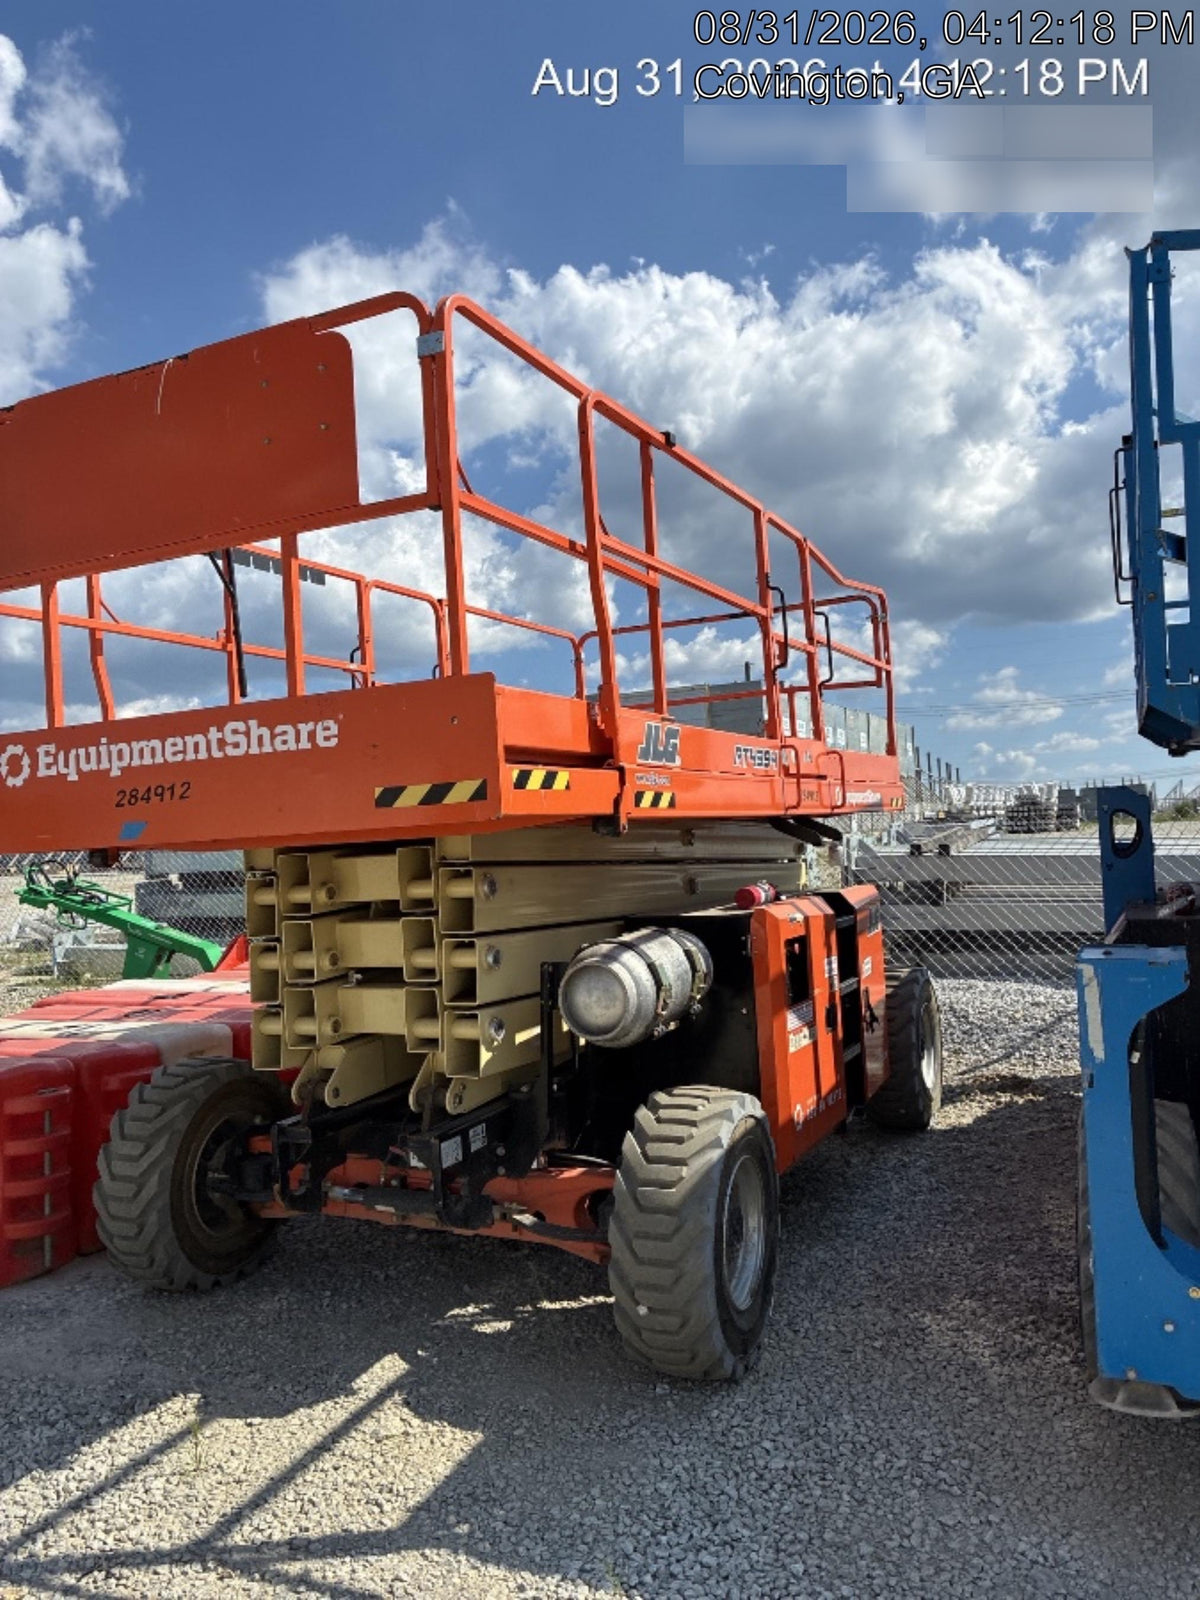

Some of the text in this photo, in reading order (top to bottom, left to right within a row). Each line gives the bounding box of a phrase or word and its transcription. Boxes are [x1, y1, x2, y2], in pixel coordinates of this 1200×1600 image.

[36, 718, 339, 782] EquipmentShare
[637, 722, 680, 766] JLG
[114, 780, 192, 808] 284912
